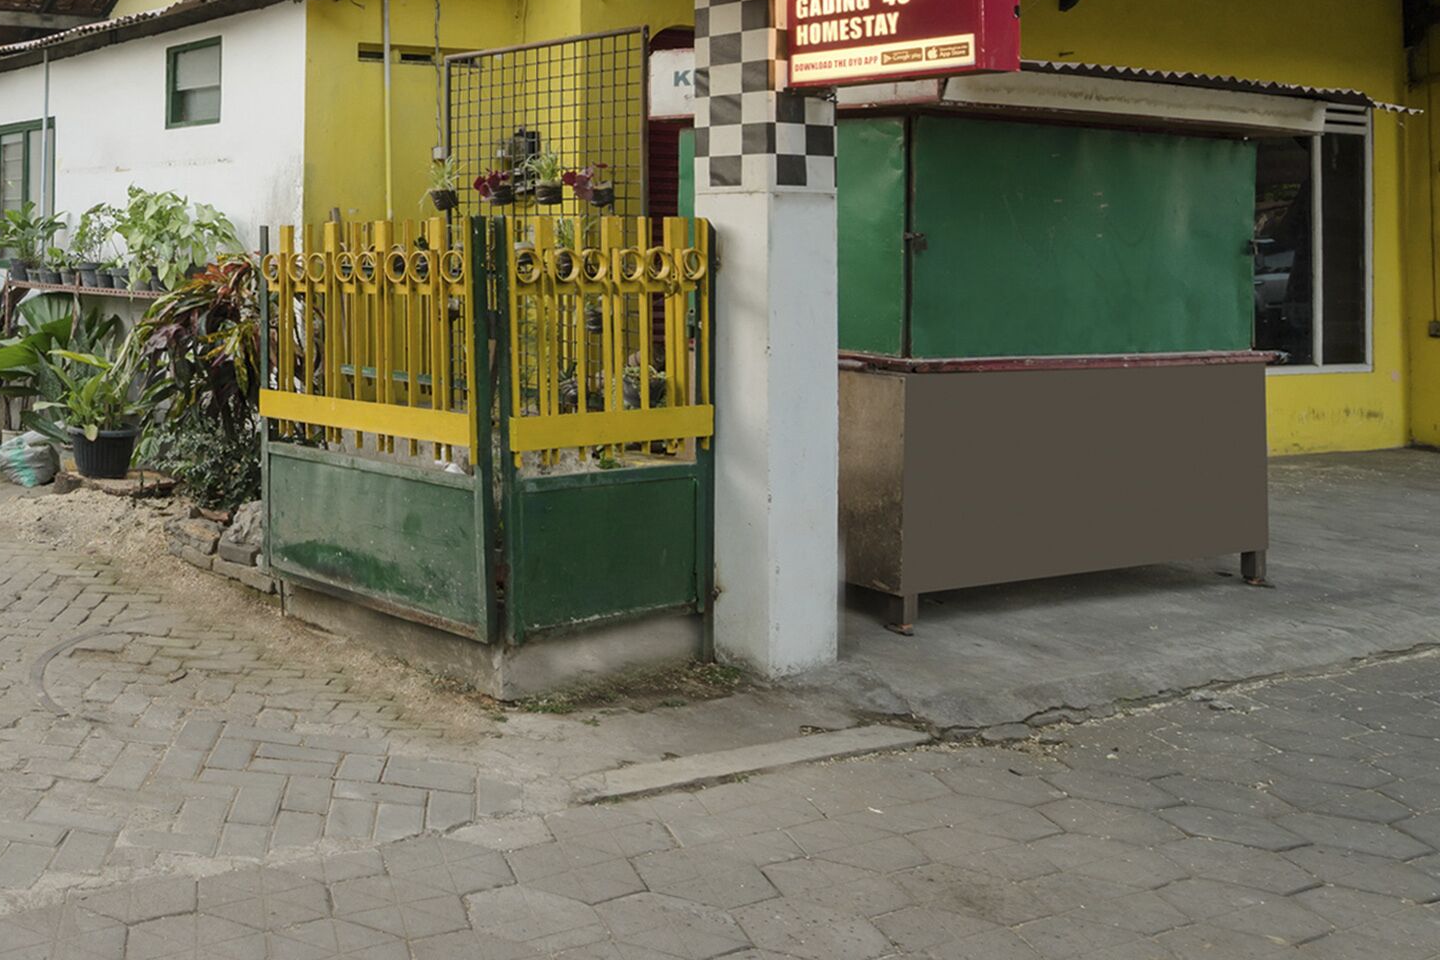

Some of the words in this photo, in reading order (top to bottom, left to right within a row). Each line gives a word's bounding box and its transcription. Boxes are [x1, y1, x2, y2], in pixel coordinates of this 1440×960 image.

[796, 11, 899, 46] HOMESTAY
[794, 60, 833, 72] DOWNLOAD
[834, 59, 846, 68] THE
[848, 57, 862, 66] OYO
[864, 55, 878, 65] APP
